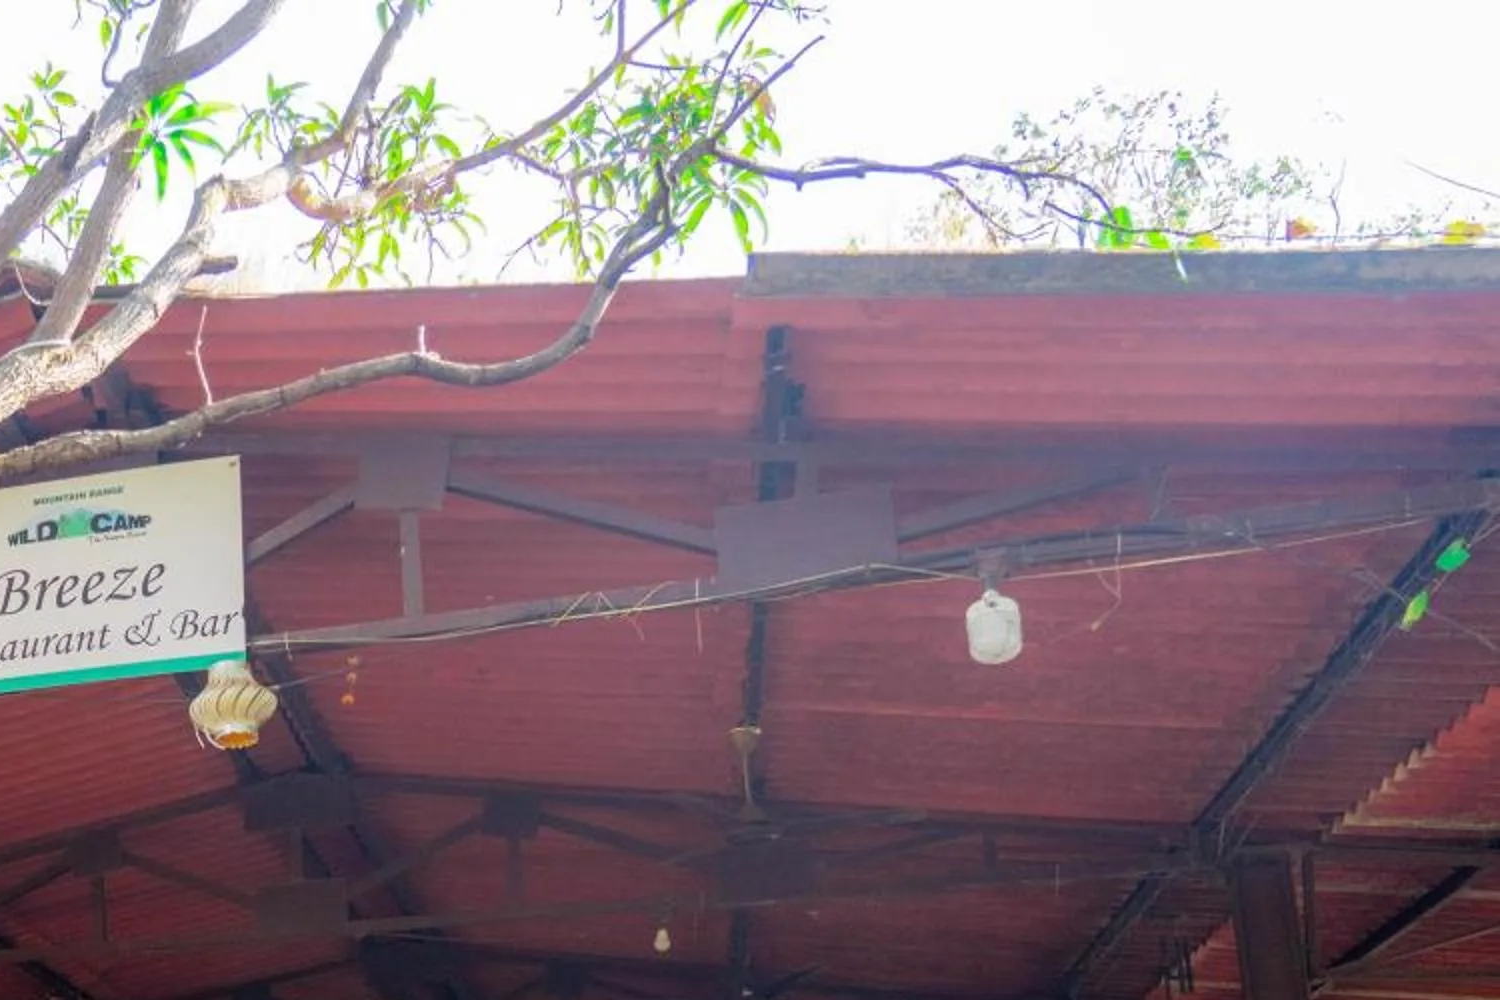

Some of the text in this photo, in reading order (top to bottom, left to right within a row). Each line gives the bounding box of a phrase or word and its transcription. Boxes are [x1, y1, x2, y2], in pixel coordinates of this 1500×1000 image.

[32, 485, 125, 506] MOUNTAIN RANGE
[7, 513, 152, 547] WILD CAMP
[125, 610, 162, 647] &
[169, 609, 239, 641] Bar
